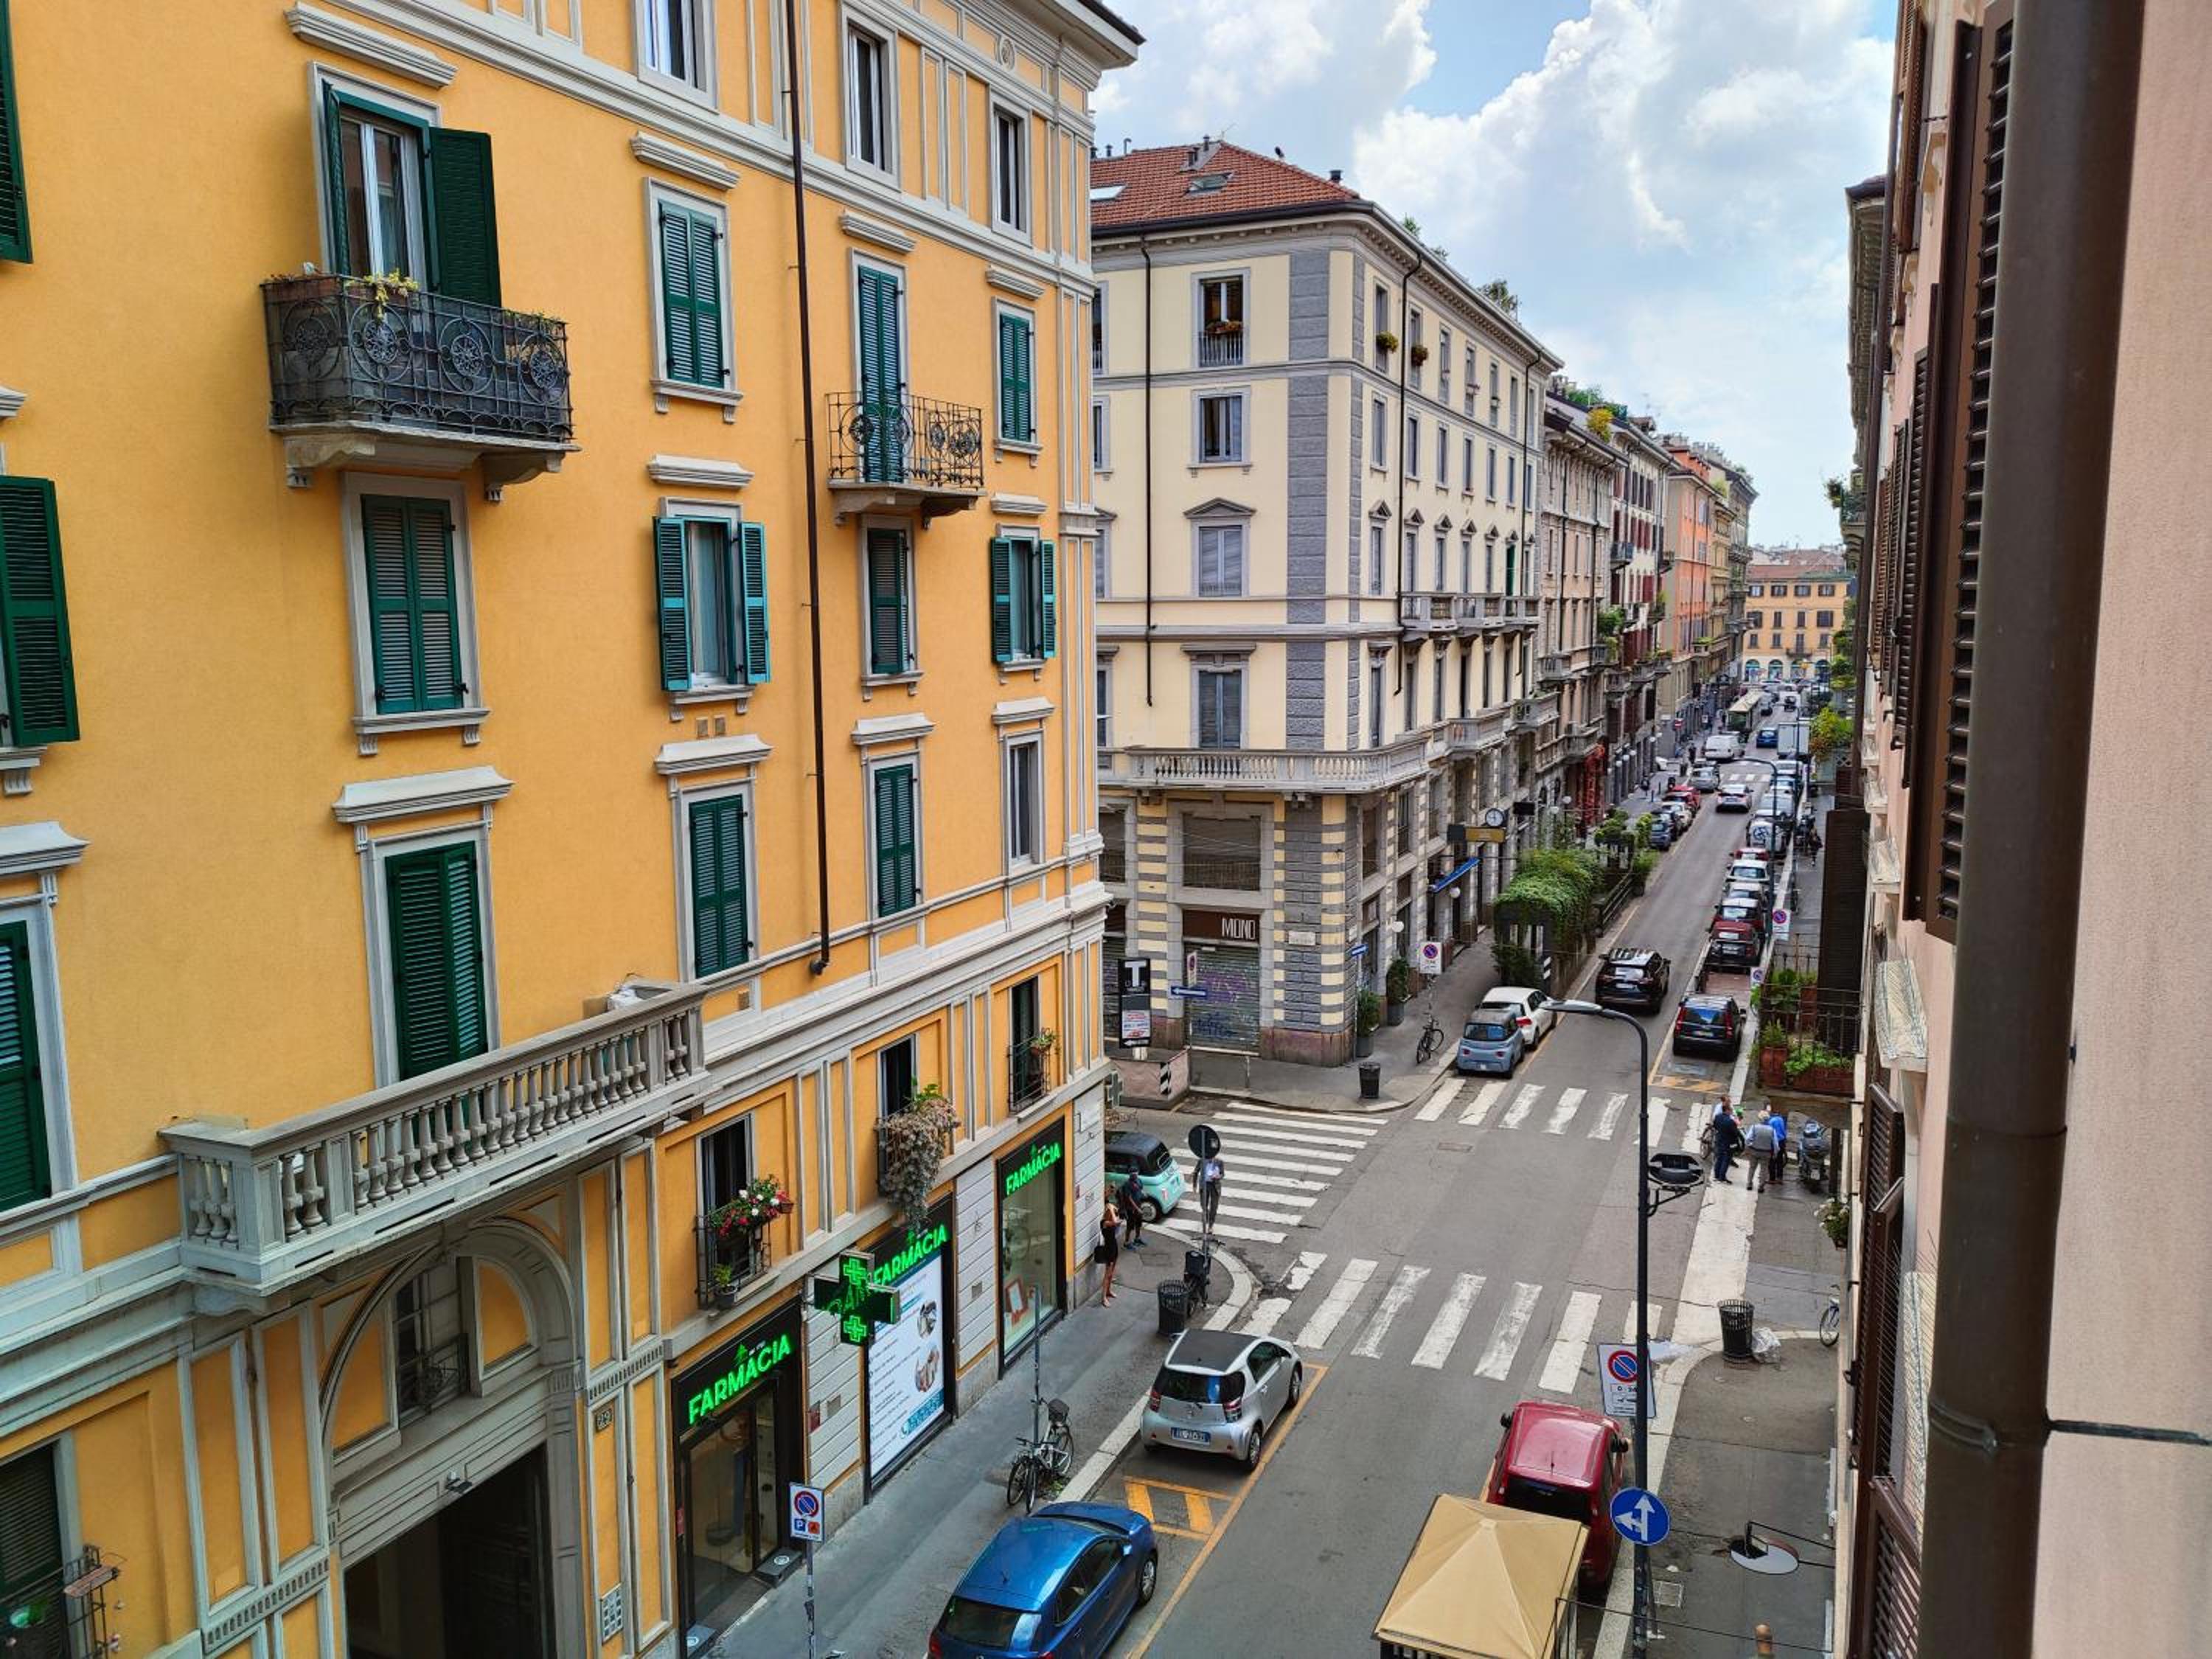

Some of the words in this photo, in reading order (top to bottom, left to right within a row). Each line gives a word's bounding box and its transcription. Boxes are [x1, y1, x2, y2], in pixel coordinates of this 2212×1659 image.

[1222, 918, 1256, 939] MONO
[1124, 961, 1147, 987] T
[1006, 1142, 1060, 1195] FARMACIA
[874, 1224, 947, 1285] FARMACIA
[688, 1334, 791, 1425] FARMACIA
